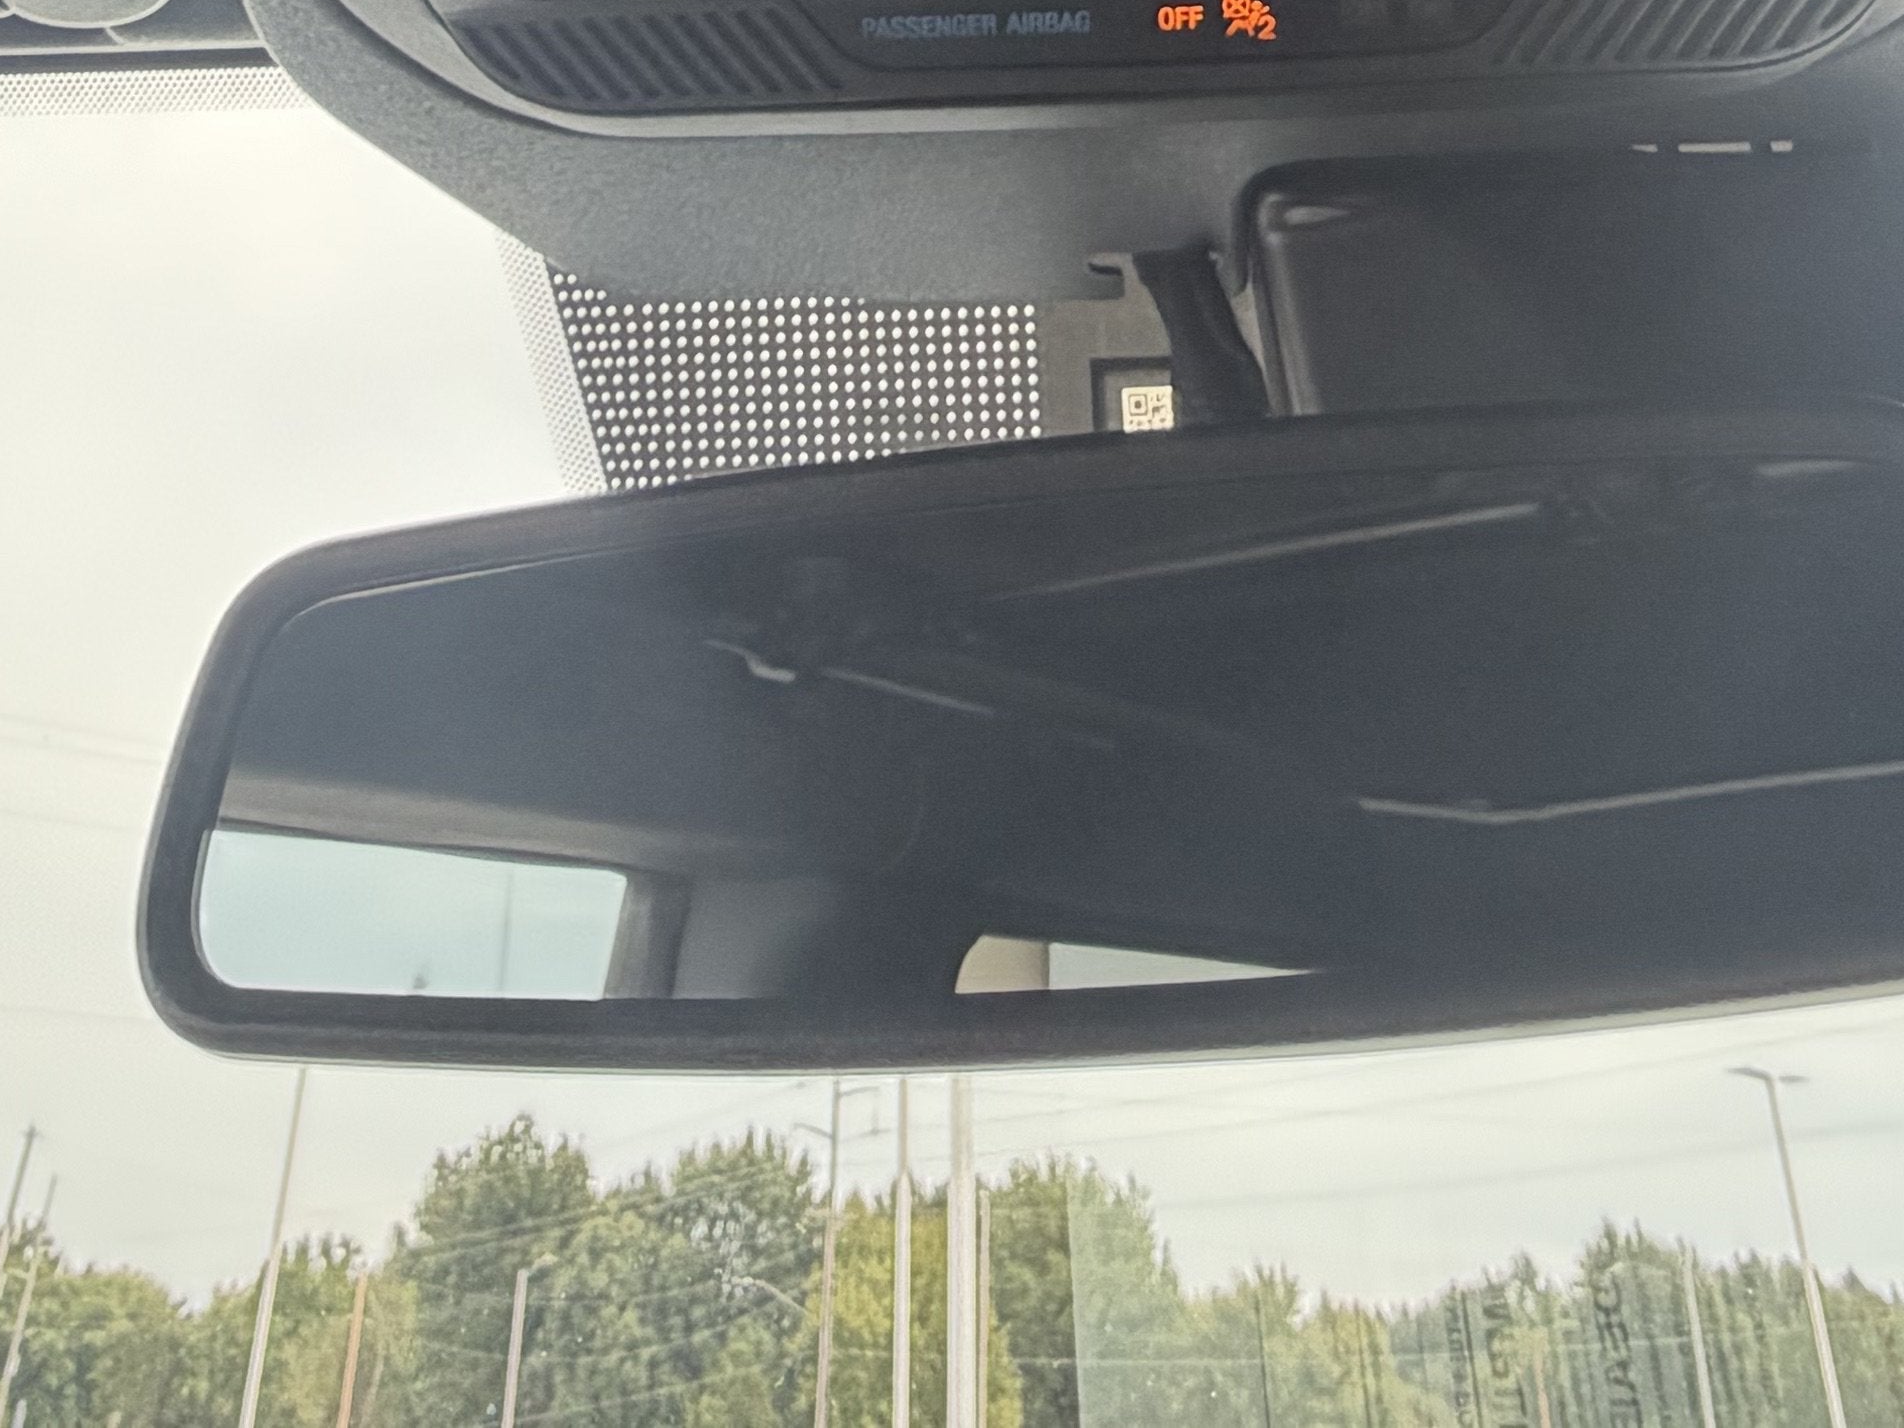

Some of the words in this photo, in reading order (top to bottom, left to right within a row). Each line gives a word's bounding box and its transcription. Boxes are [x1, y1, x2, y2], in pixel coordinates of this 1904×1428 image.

[861, 14, 996, 38] PASSENGER
[1006, 10, 1092, 35] AIRBAG
[1157, 5, 1204, 32] OFF
